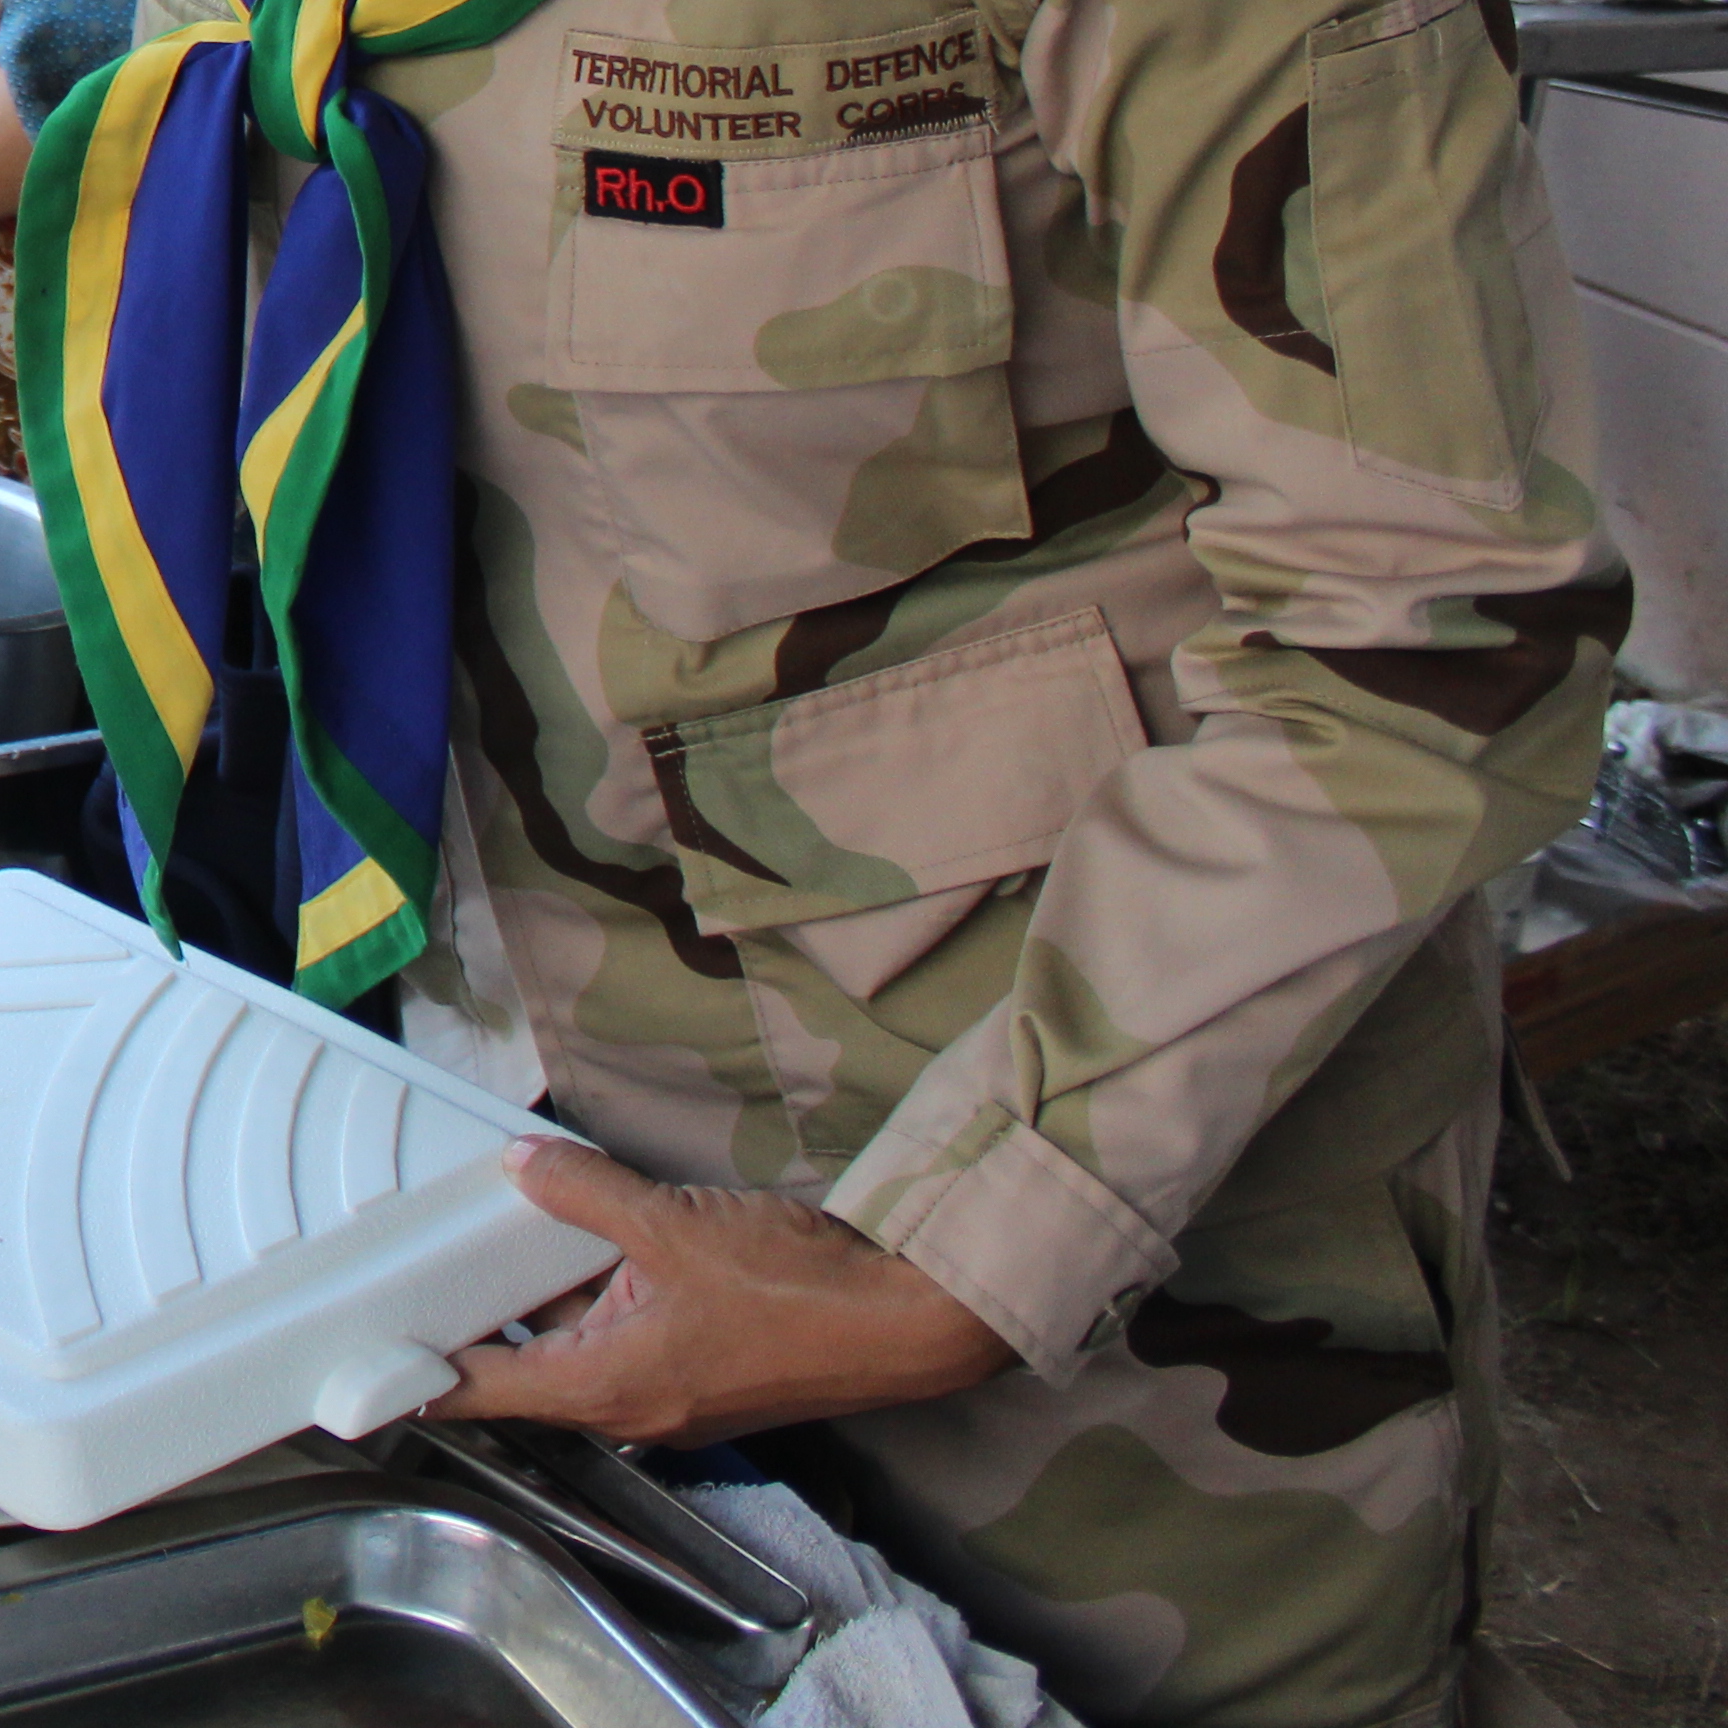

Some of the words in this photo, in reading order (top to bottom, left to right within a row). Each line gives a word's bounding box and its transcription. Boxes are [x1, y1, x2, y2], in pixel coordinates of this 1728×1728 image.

[825, 28, 976, 92] DEFENCE
[581, 98, 801, 141] VOLUNTEER
[836, 80, 967, 130] CORPS
